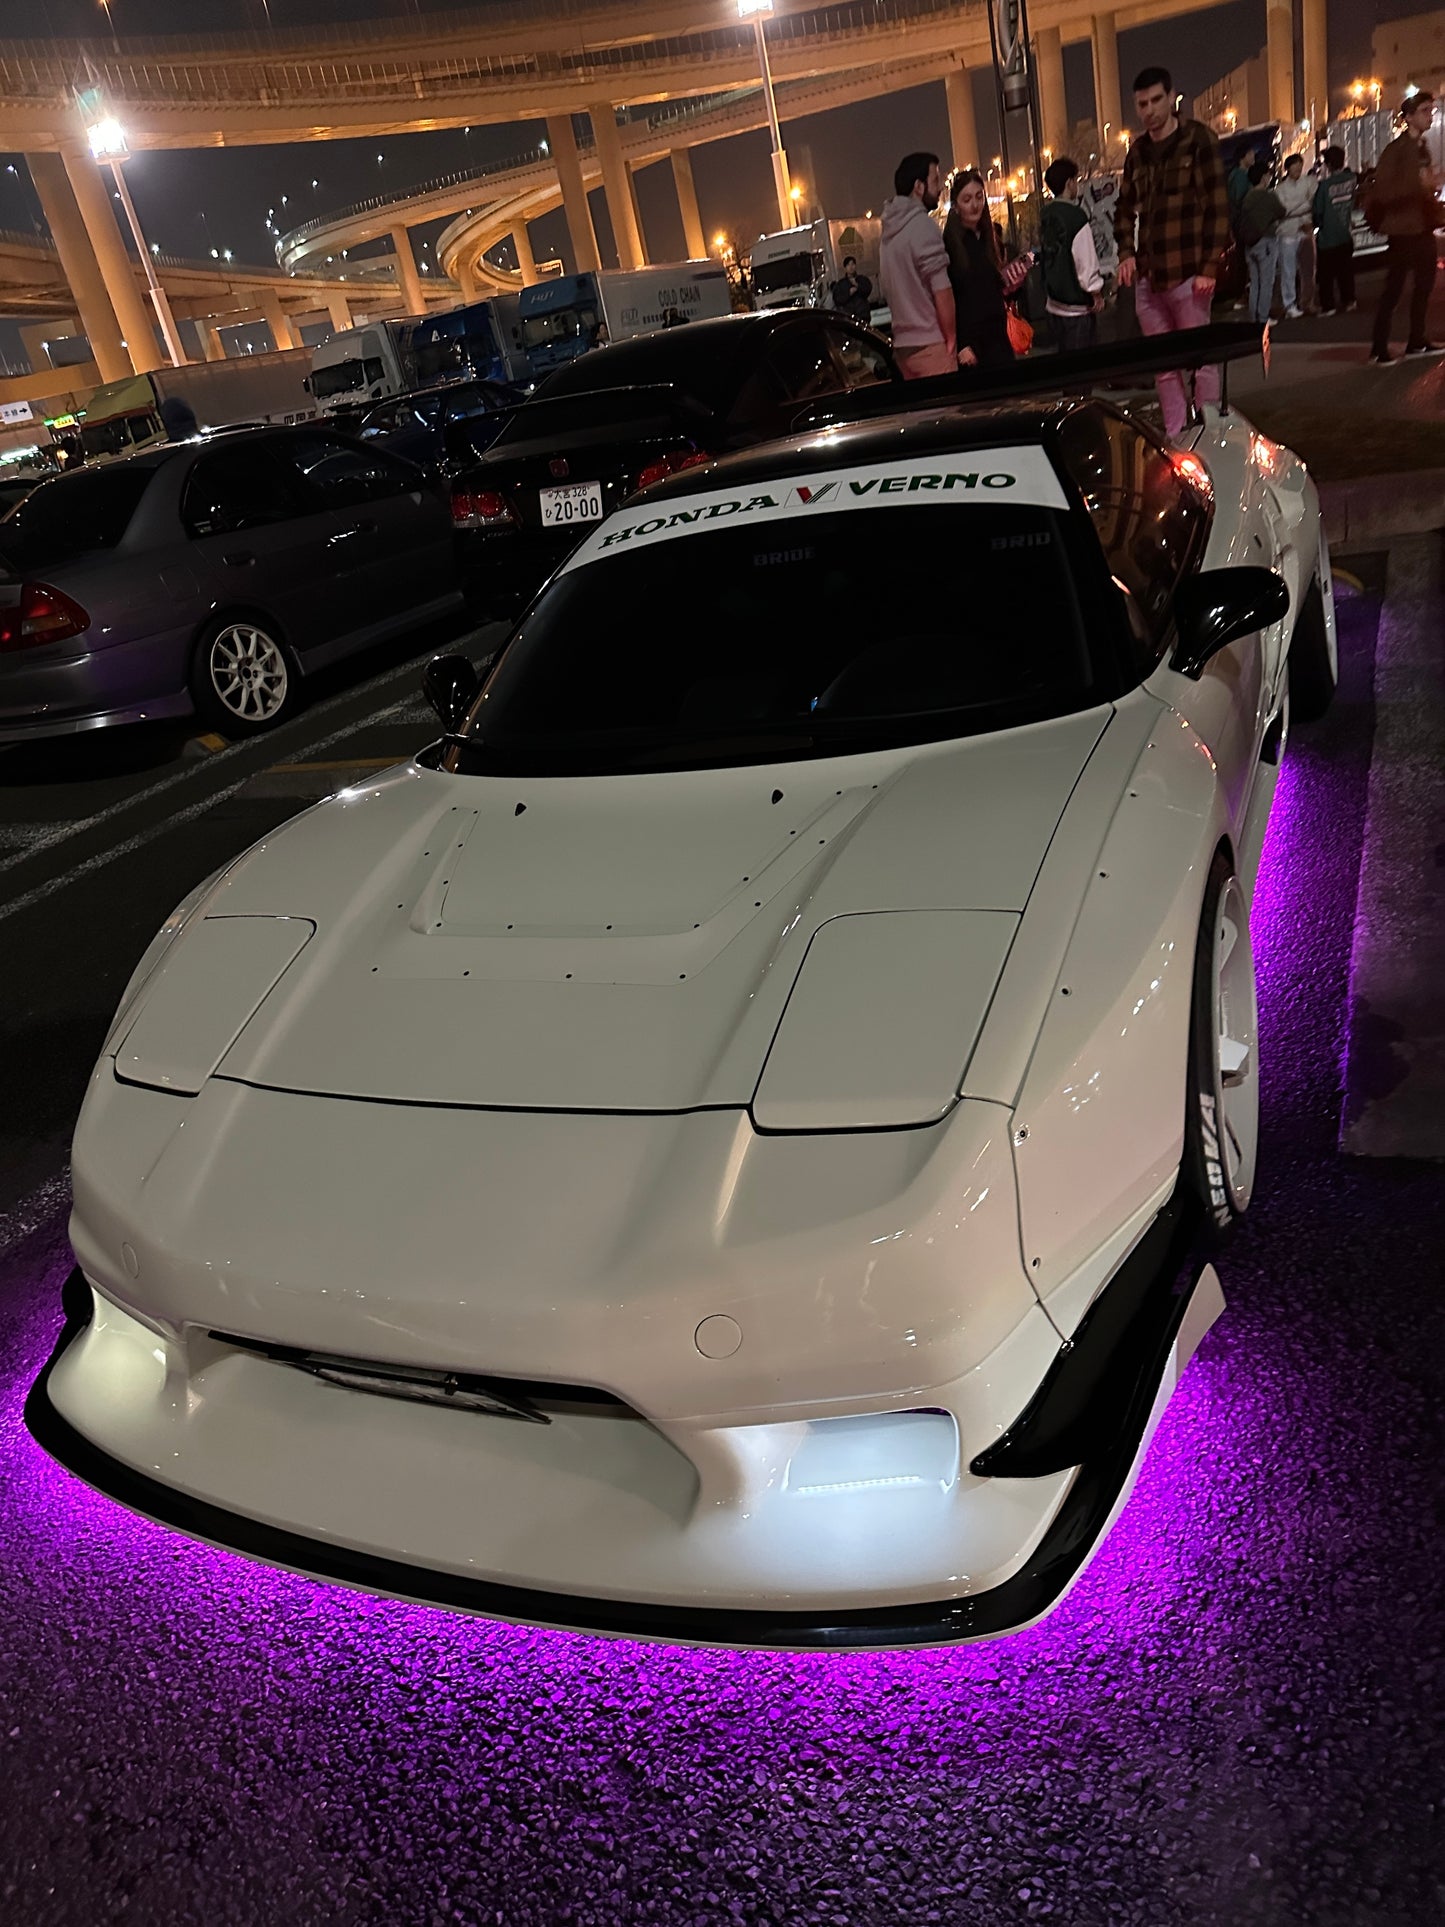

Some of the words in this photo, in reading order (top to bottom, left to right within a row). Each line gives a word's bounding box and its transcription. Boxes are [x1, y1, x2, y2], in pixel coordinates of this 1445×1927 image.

[658, 288, 678, 307] COLD
[680, 285, 702, 303] CHAIN
[572, 485, 588, 498] 328
[554, 497, 599, 522] 20-00
[598, 495, 779, 550] HONDA
[849, 473, 1016, 496] VERNO
[991, 532, 1051, 550] BRID
[753, 546, 816, 567] BRIDE
[1200, 1093, 1232, 1227] NEOVA
